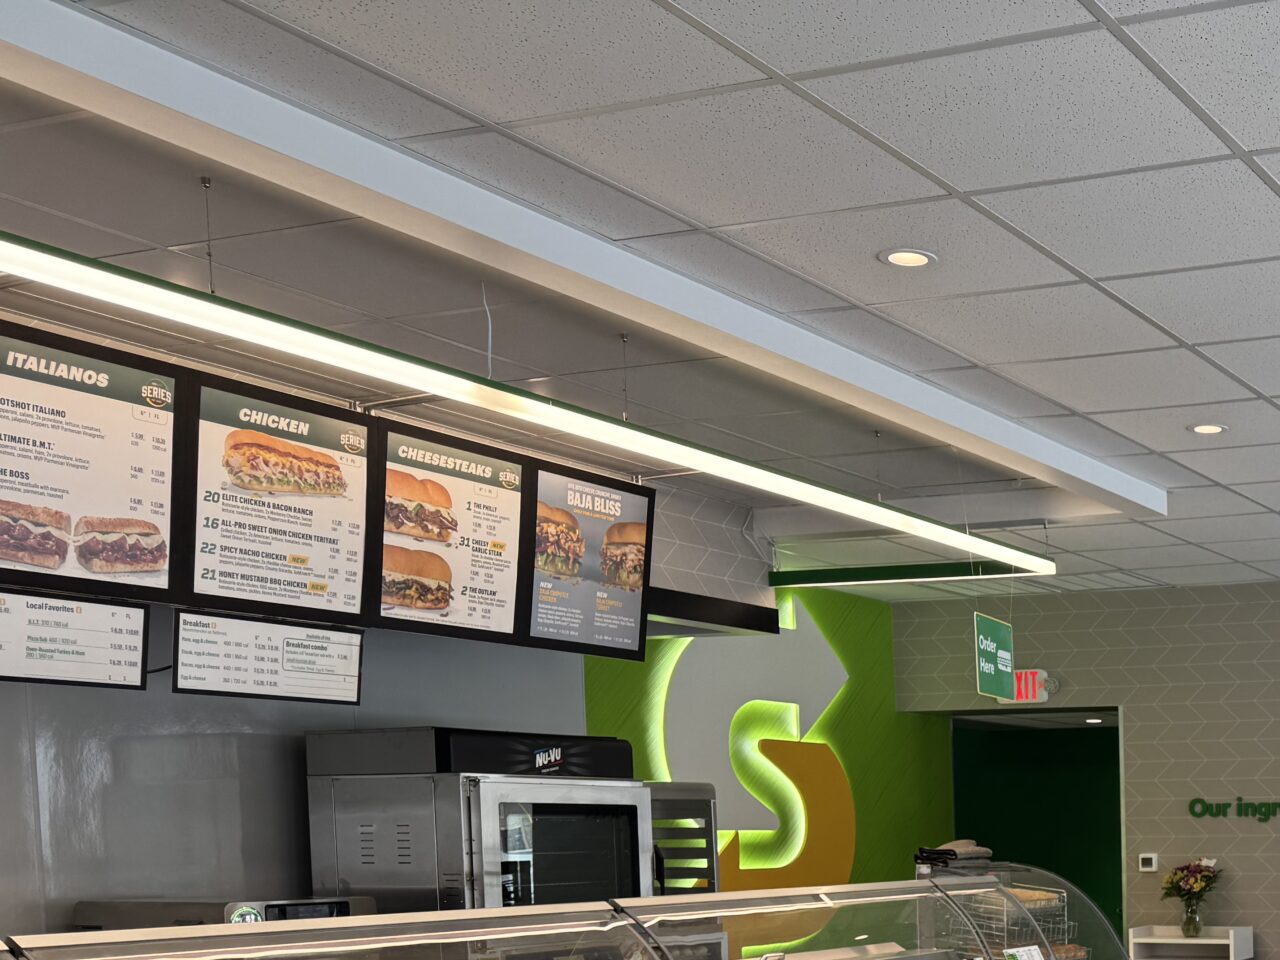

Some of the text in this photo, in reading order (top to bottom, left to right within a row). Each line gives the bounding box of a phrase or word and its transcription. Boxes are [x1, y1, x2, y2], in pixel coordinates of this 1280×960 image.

[6, 351, 110, 388] ITALIANOS
[141, 385, 172, 403] SERIES
[0, 398, 31, 411] OTSHOT
[32, 404, 66, 418] ITALIANO
[238, 407, 310, 436] CHICKEN
[0, 433, 31, 446] LTIMATE
[340, 433, 365, 450] SERIES
[398, 445, 493, 478] CHEESESTEAKS
[9, 469, 30, 480] BOSS
[499, 471, 520, 485] SERIES
[203, 490, 220, 504] 20
[222, 493, 239, 503] ELITE
[239, 496, 266, 508] CHICKEN
[272, 502, 293, 513] BACON
[293, 506, 313, 516] RANCH
[466, 501, 497, 512] 1 THE PHILLY
[567, 490, 593, 510] BAJA
[594, 496, 621, 517] BLISS
[202, 516, 220, 529] 16
[221, 519, 247, 530] ALL-PRO
[247, 523, 268, 534] SWEET
[268, 527, 288, 537] ONION
[288, 530, 313, 541] CHICKEN
[313, 535, 339, 545] TERIYAKI
[458, 536, 471, 548] 31
[471, 538, 489, 547] CHEESY
[200, 542, 217, 555] 22
[219, 545, 238, 554] SPICY
[238, 548, 261, 557] NACHO
[261, 551, 287, 562] CHICKEN
[291, 556, 306, 564] NEW
[471, 546, 503, 557] GARLIC STEAK
[201, 568, 217, 581] 21
[218, 570, 240, 580] HONEY
[240, 573, 269, 584] MUSTARD
[269, 577, 282, 585] BBQ
[282, 579, 308, 589] CHICKEN
[310, 583, 326, 591] NEW
[461, 586, 497, 596] 2 THE OUTLAW
[596, 591, 608, 599] NEW
[26, 601, 75, 614] Local Favorites
[182, 619, 211, 629] Breakfast
[285, 641, 328, 651] Breakfast combo
[978, 634, 997, 653] Order
[979, 657, 995, 675] Here
[1014, 671, 1038, 702] XIT
[535, 747, 562, 768] NU-VU
[1188, 797, 1232, 818] Our
